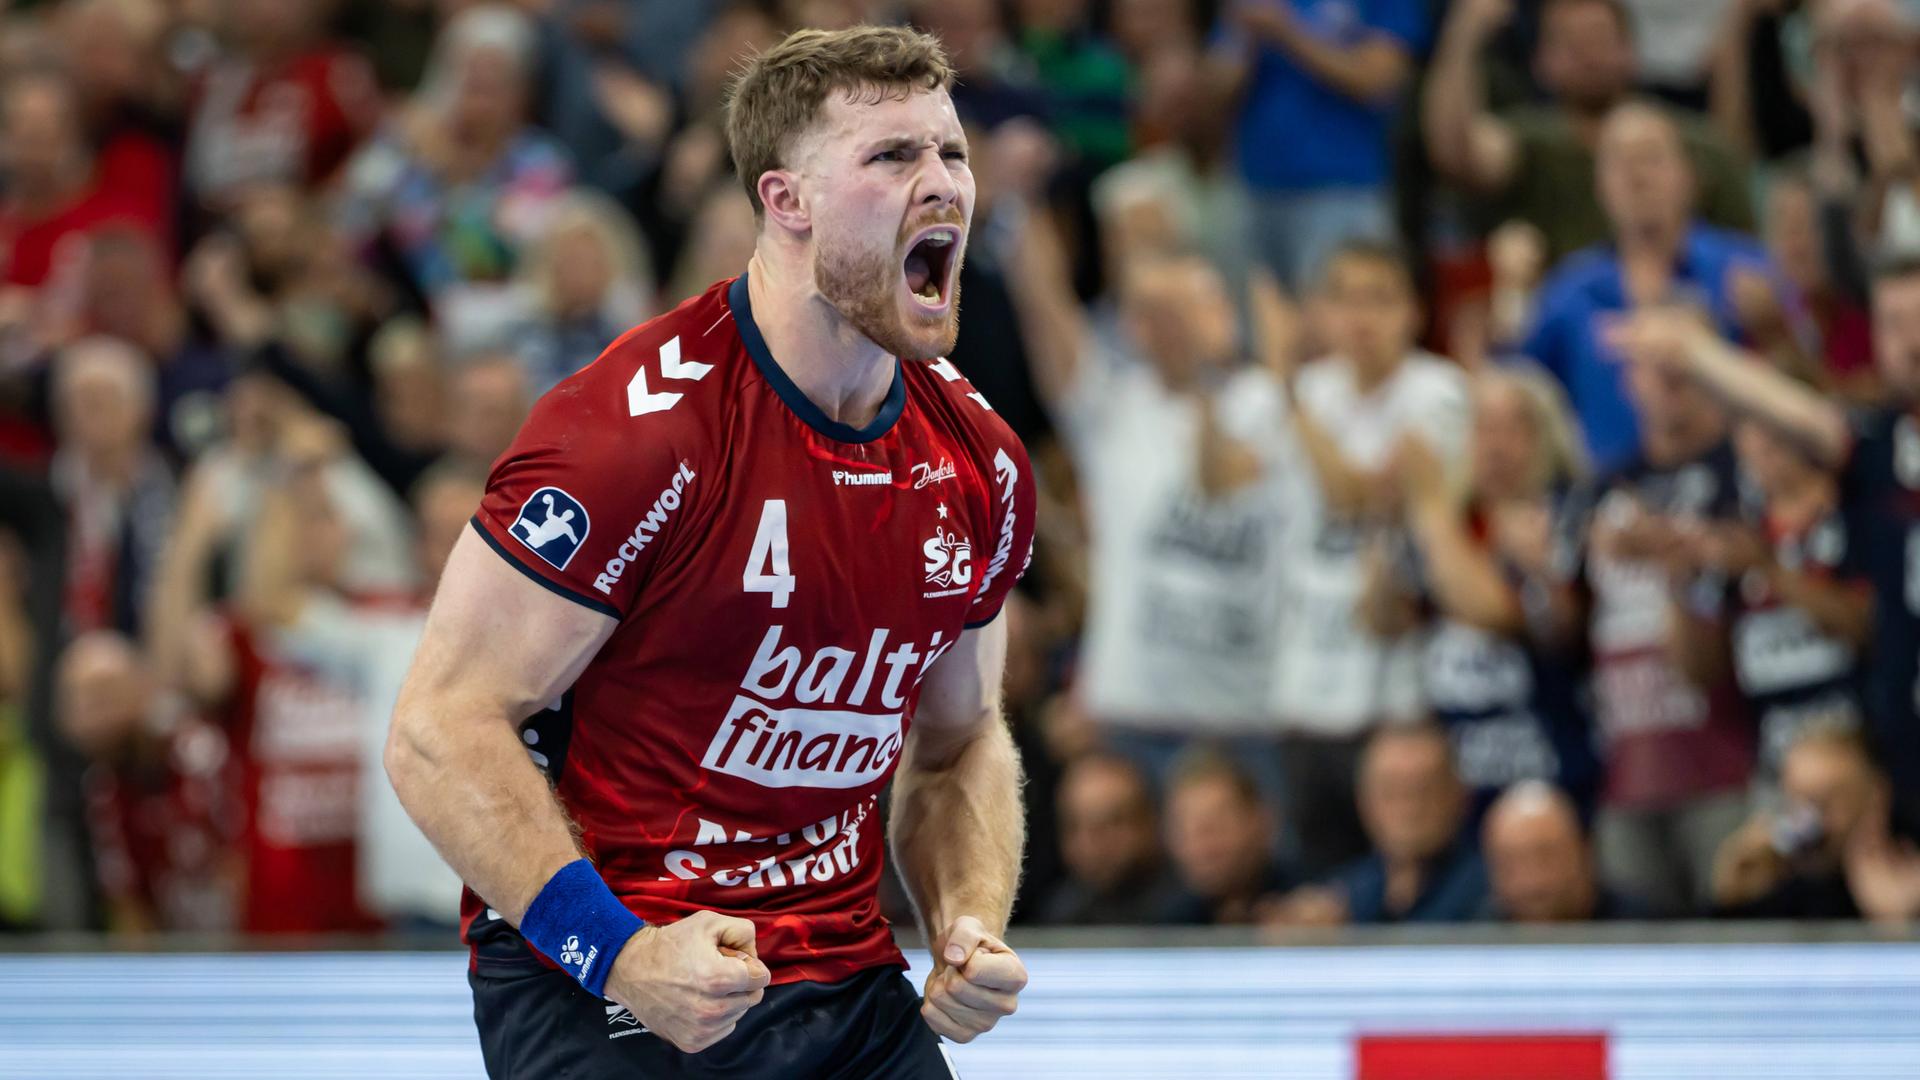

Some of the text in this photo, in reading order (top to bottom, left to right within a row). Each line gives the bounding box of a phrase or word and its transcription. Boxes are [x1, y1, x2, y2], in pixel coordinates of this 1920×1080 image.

[844, 470, 892, 486] humme
[911, 456, 957, 490] Danfoss
[592, 461, 696, 595] ROCKWOOL
[743, 499, 796, 609] 4
